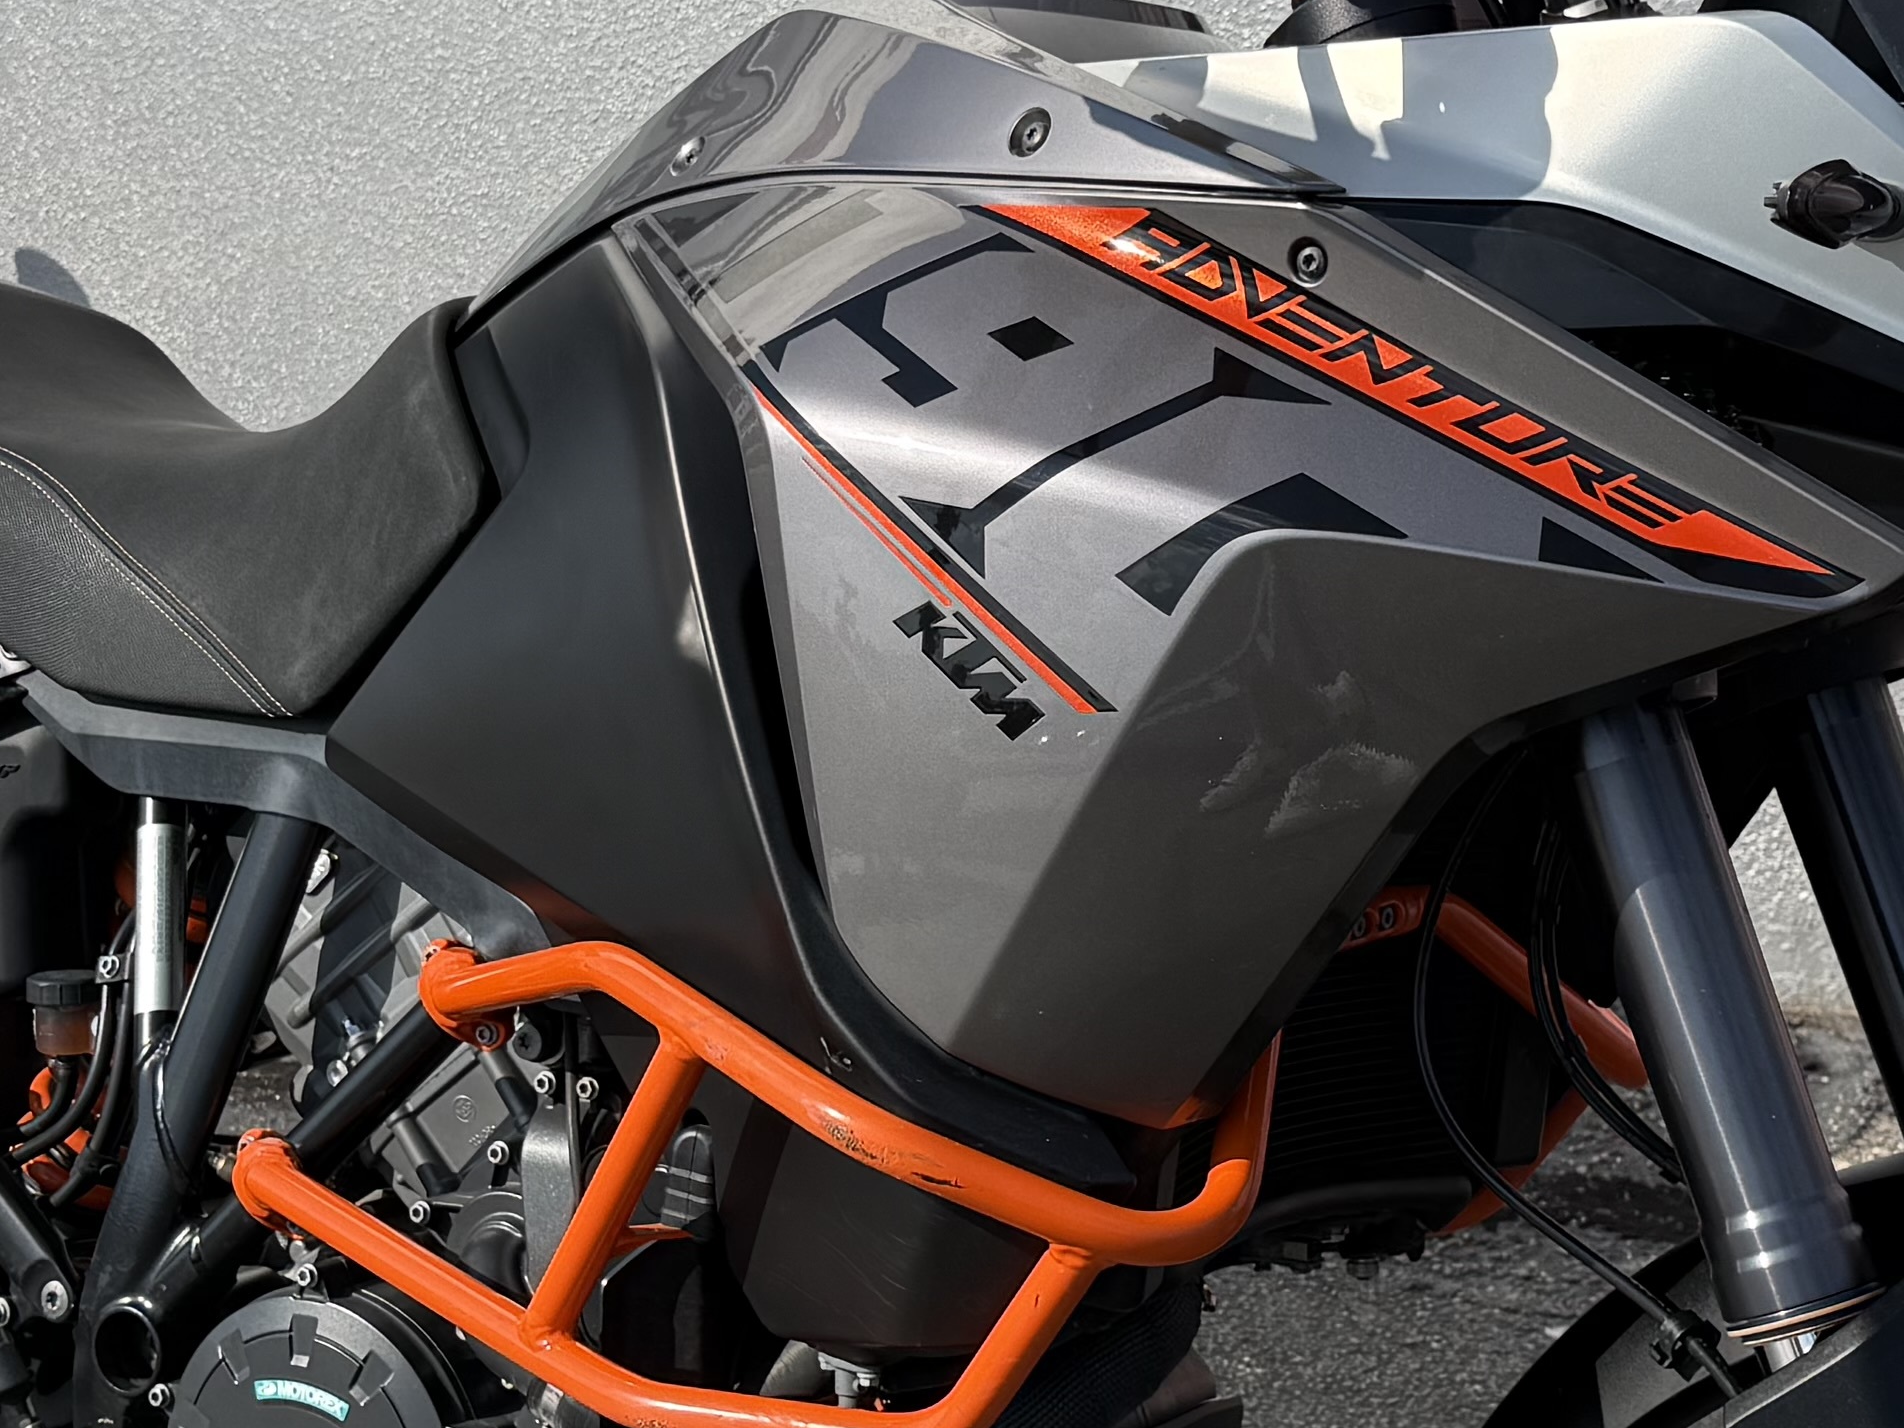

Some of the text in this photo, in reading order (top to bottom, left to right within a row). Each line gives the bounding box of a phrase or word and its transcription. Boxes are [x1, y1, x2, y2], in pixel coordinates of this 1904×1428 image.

[1108, 214, 1688, 530] ADVENTURE
[893, 599, 1045, 742] KTM
[277, 1380, 345, 1420] MOTOREX
